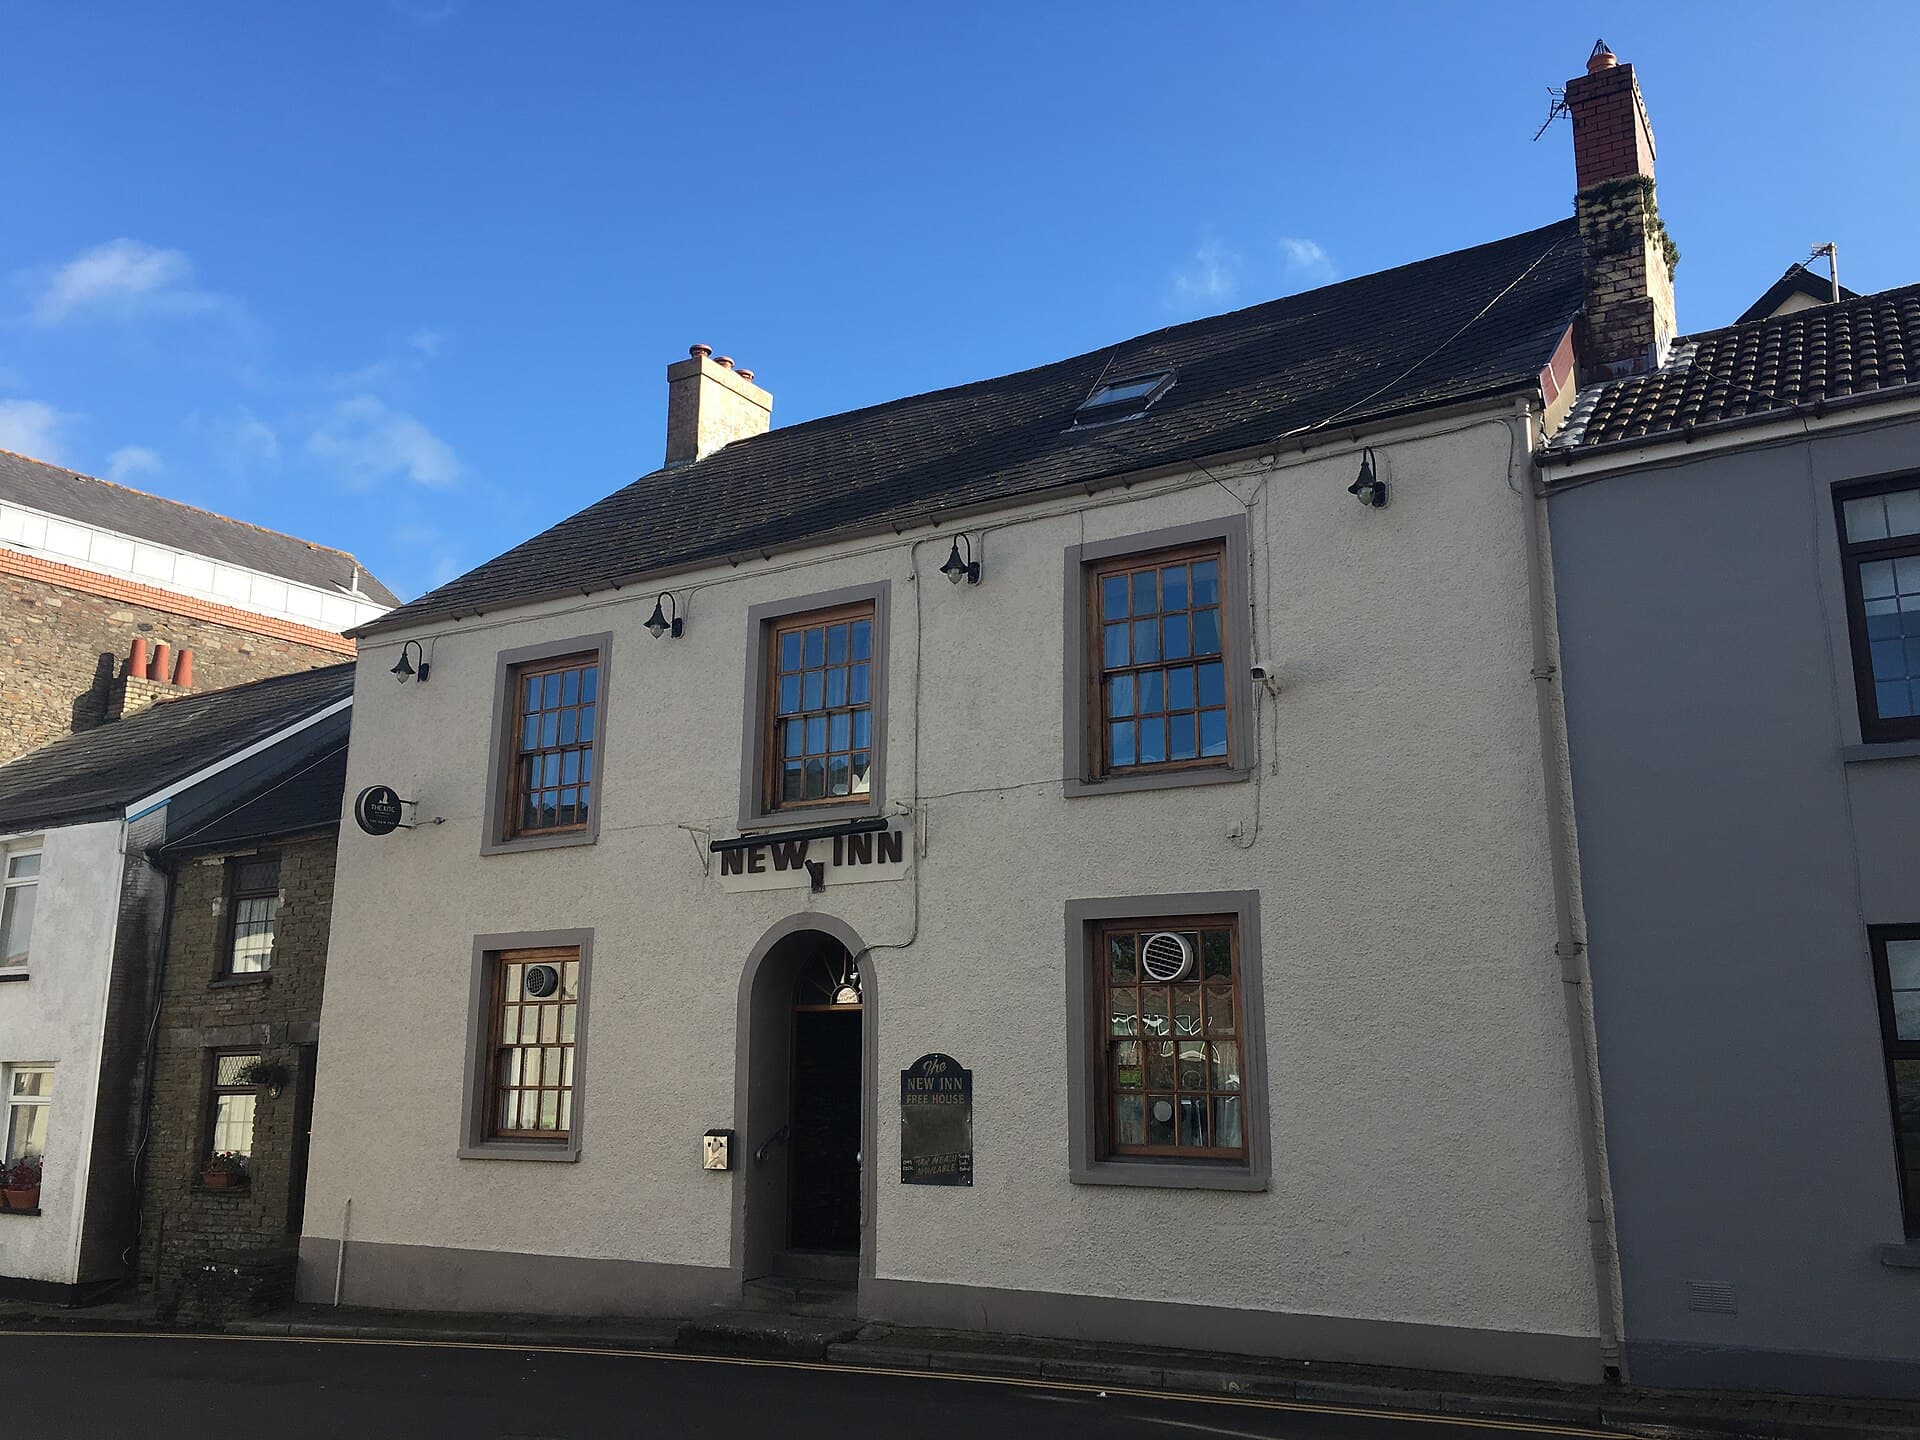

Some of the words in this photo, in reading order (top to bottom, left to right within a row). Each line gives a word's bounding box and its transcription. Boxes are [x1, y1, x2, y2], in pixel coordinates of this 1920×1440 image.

[721, 839, 809, 876] NEW
[833, 831, 902, 867] INN
[923, 1059, 948, 1077] The
[908, 1077, 934, 1090] NEW
[940, 1077, 963, 1090] INN
[906, 1094, 928, 1104] FREE
[932, 1094, 965, 1104] HOUSE
